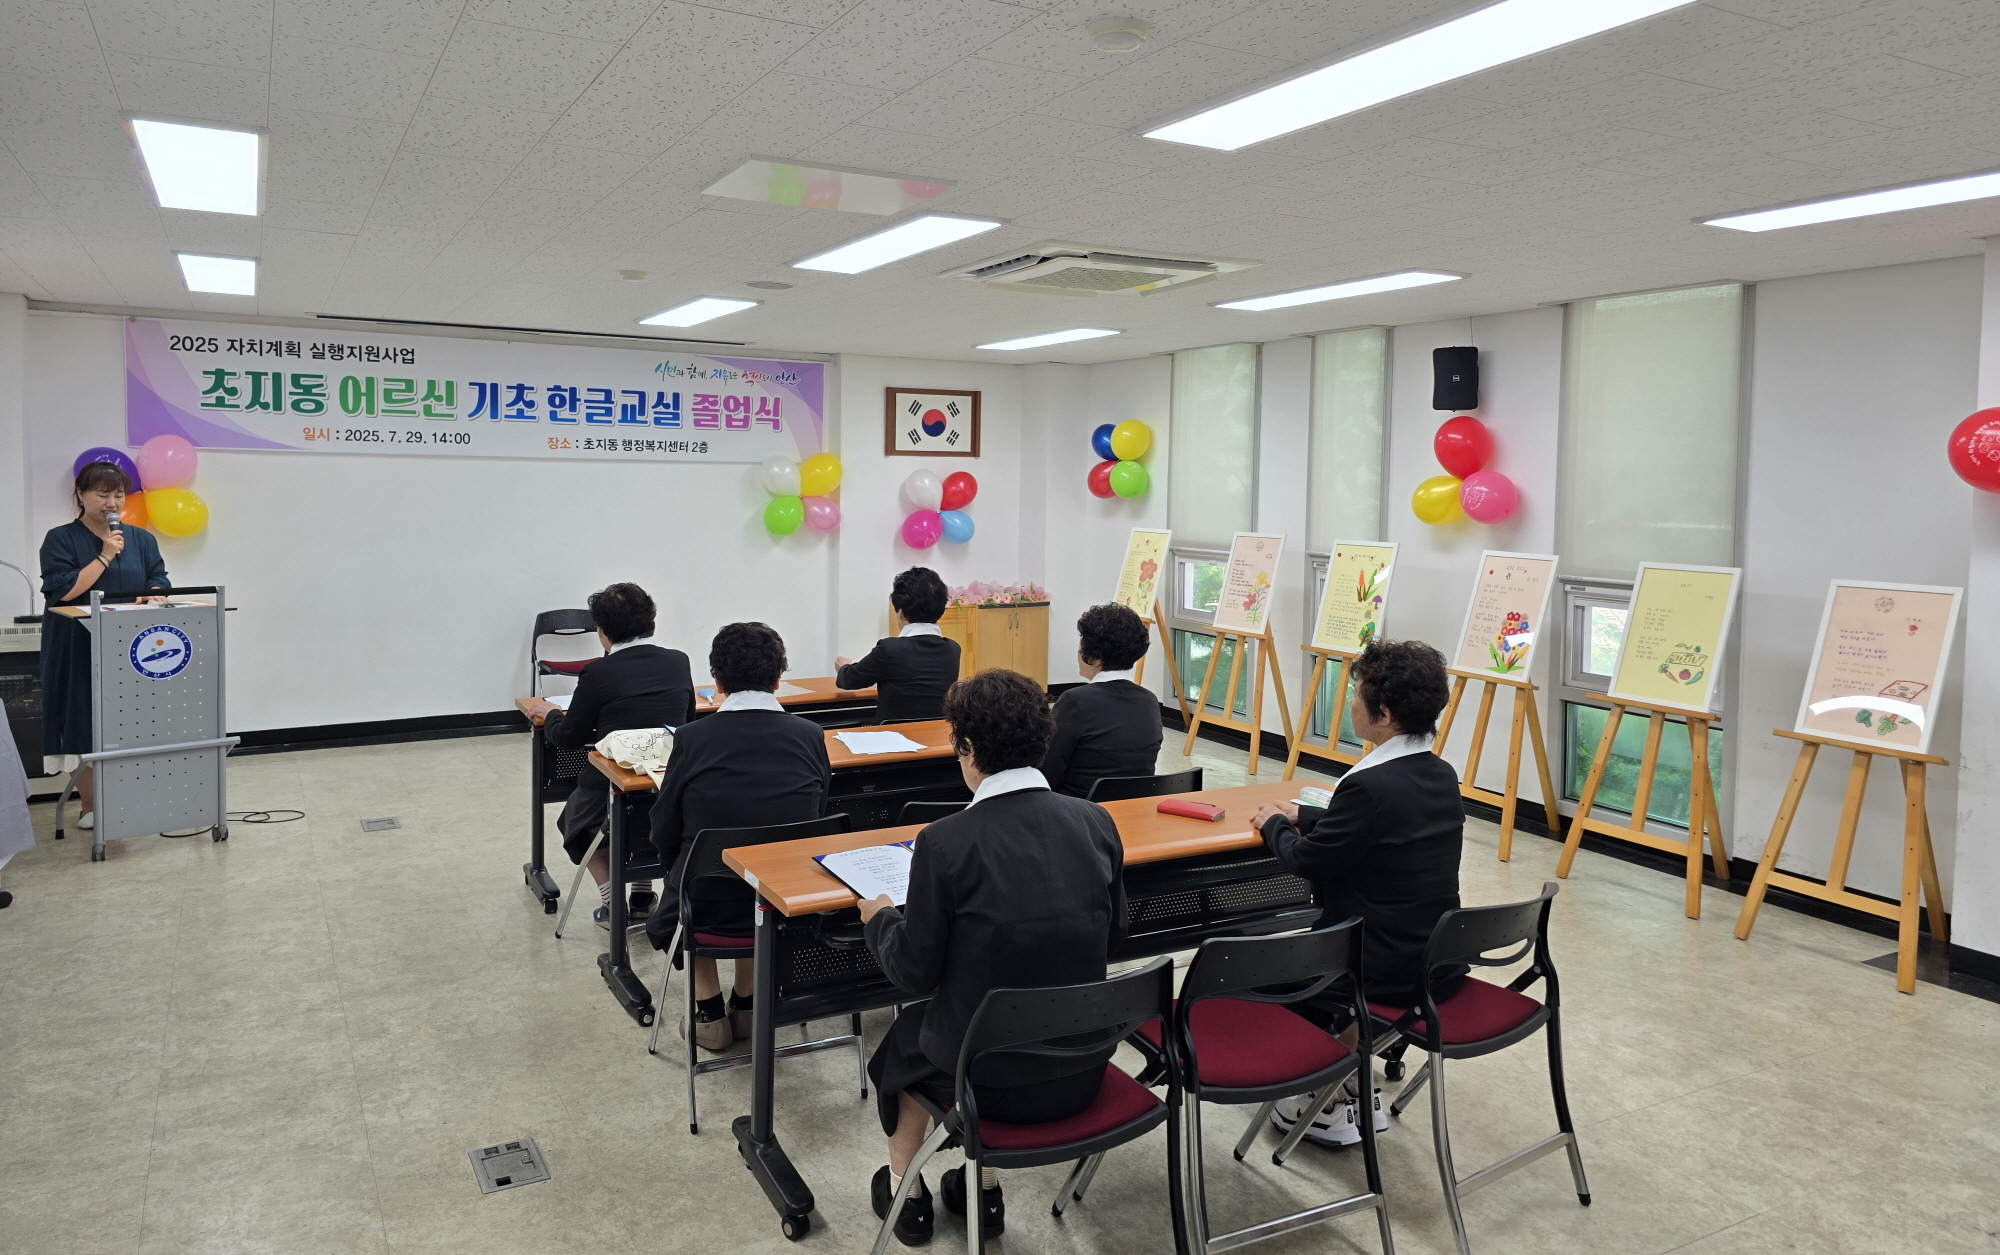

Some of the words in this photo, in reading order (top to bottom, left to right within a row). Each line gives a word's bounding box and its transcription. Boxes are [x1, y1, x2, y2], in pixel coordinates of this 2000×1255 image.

[169, 335, 219, 353] 2025
[226, 338, 301, 359] 자치계획
[309, 342, 415, 365] 실행지원사업
[654, 359, 686, 382] 시민과
[775, 371, 801, 386] 안산
[201, 367, 327, 415] 초지동
[338, 375, 456, 419] 어르신
[467, 381, 538, 421] 기초
[546, 385, 682, 428] 한글교실
[691, 393, 782, 431] 졸업식
[302, 427, 330, 441] 일시
[344, 429, 384, 443] 2025.
[389, 430, 402, 444] 7.
[405, 431, 427, 444] 29.
[431, 431, 471, 445] 14:00
[547, 436, 571, 450] 장소
[583, 438, 619, 451] 초지동
[621, 439, 689, 453] 행정복지센터
[691, 441, 709, 454] 2층
[172, 628, 189, 643] CITY
